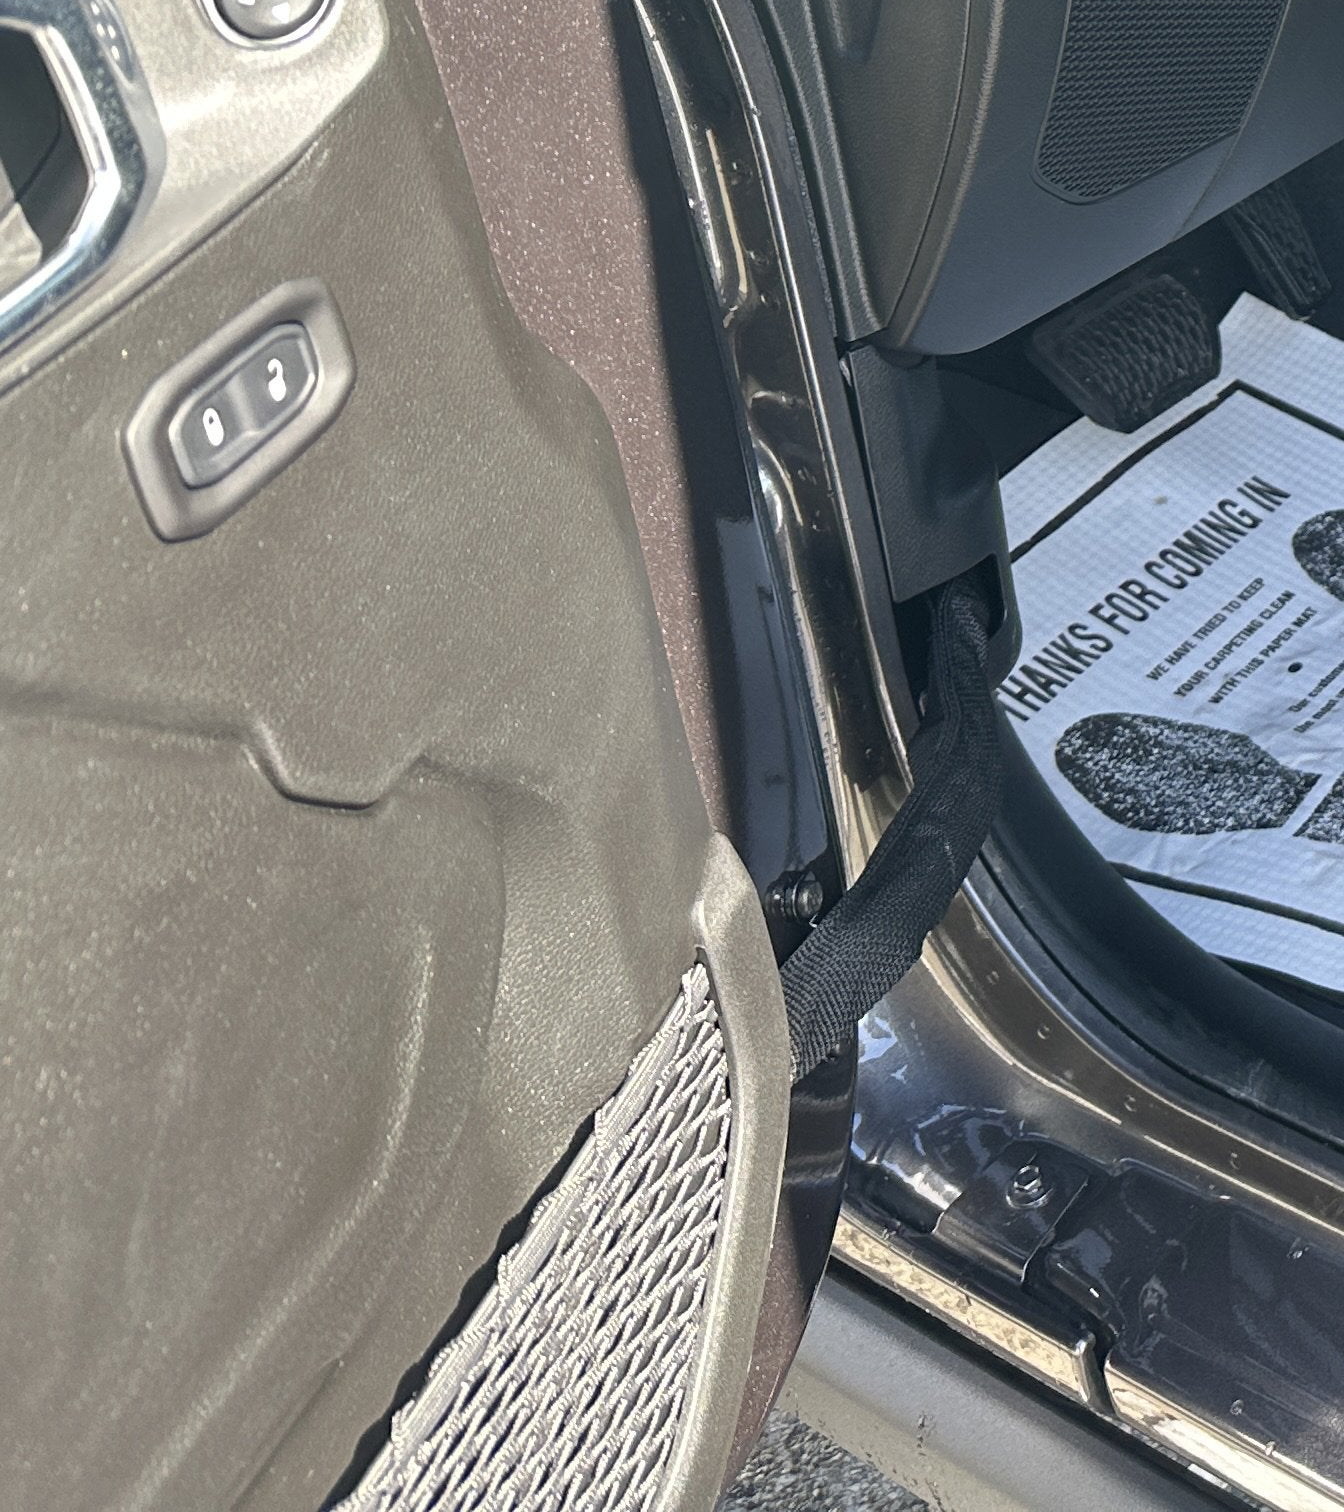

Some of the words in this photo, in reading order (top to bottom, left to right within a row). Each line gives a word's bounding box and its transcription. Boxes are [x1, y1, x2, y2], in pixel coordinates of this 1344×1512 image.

[1088, 578, 1170, 635] FOR
[1144, 498, 1263, 589] COMING
[1236, 475, 1291, 513] IN
[1146, 663, 1170, 681] WE
[1164, 640, 1197, 665] HAVE
[1192, 613, 1227, 640] TRIED
[1221, 600, 1241, 613] TO
[1237, 577, 1265, 601] KEEP
[1173, 669, 1209, 697] YOUR
[1204, 619, 1264, 670] CARPETING
[1259, 590, 1296, 620] CLEAN
[1208, 677, 1241, 704] WITH
[1234, 657, 1264, 678] THIS
[1259, 627, 1297, 658] PAPER
[1291, 606, 1317, 628] MAT
